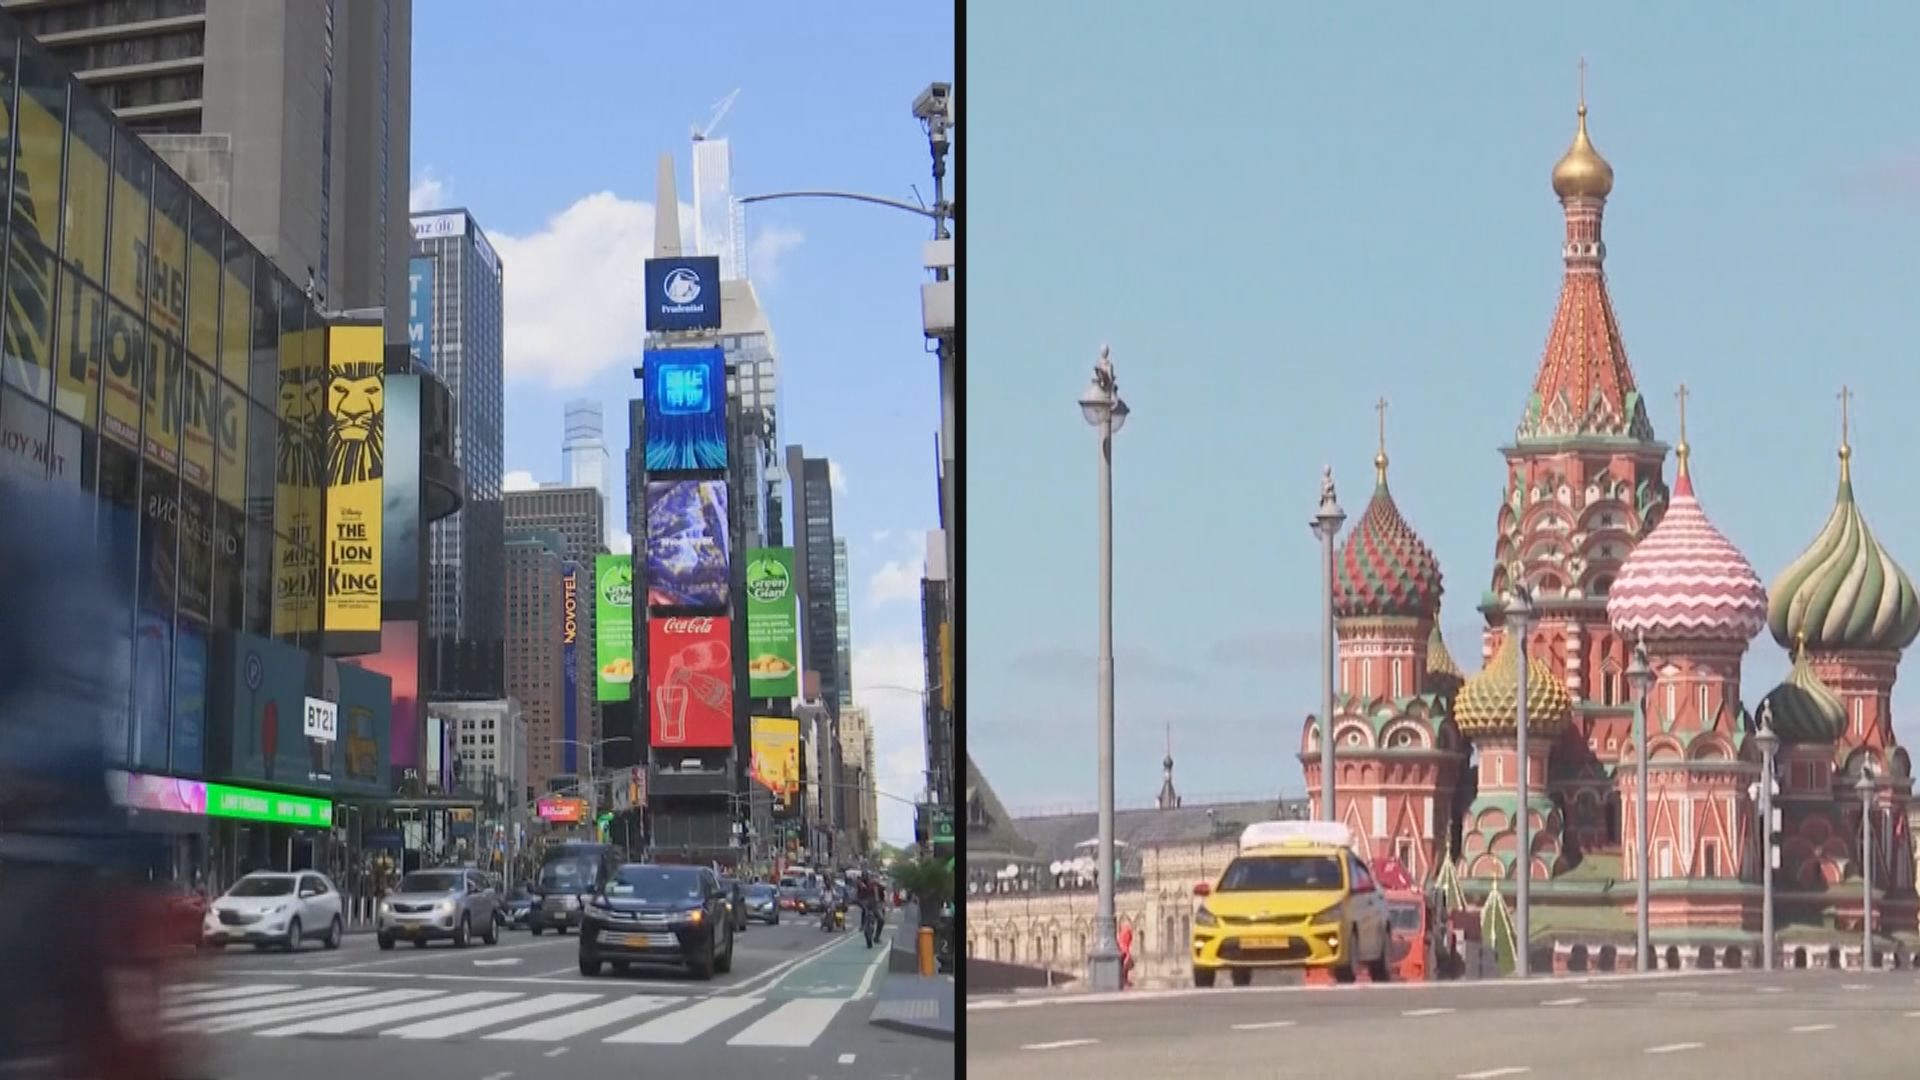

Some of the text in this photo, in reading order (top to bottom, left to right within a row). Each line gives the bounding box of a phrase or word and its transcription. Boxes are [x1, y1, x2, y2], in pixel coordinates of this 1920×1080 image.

[662, 304, 704, 313] Prudential
[337, 523, 366, 537] THE
[332, 541, 372, 565] LION
[328, 567, 378, 596] KING
[750, 579, 786, 590] Green
[564, 571, 576, 644] NOVOTEL
[308, 705, 334, 732] BT21
